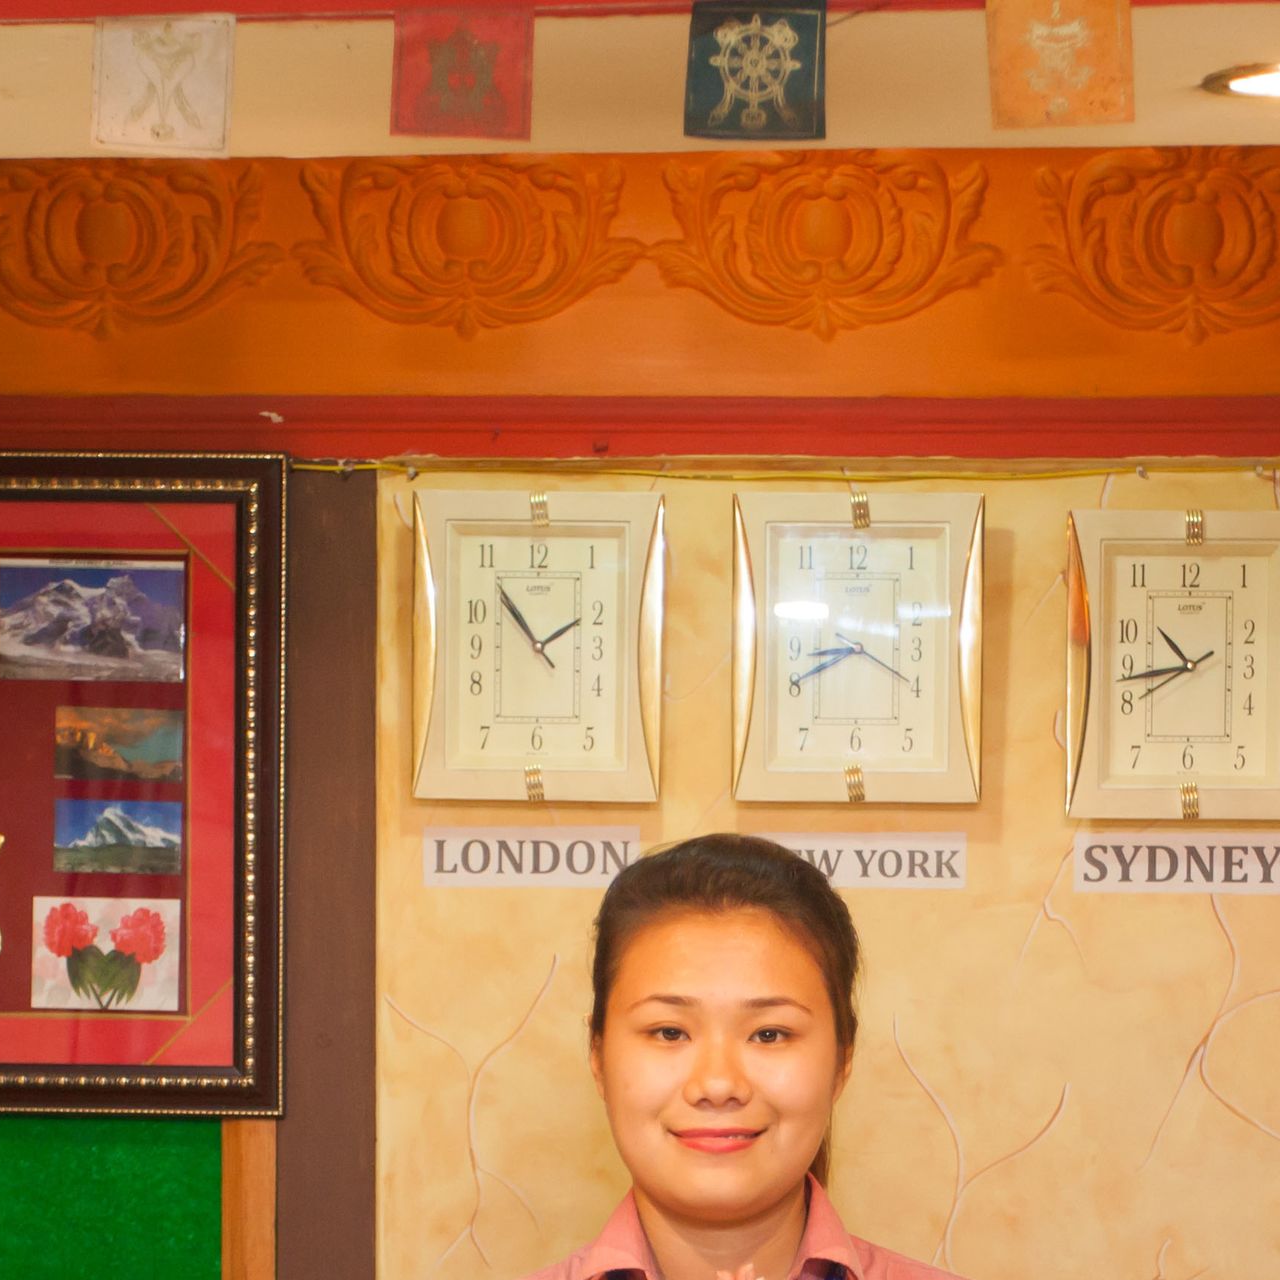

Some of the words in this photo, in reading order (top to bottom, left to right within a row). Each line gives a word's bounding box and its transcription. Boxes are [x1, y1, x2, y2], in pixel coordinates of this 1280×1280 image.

[479, 544, 494, 568] 11
[529, 543, 548, 569] 12
[588, 545, 595, 569] 1
[799, 545, 814, 570] 11
[848, 545, 867, 570] 12
[908, 546, 914, 570] 1
[1131, 563, 1146, 588] 11
[1181, 563, 1200, 588] 12
[1241, 564, 1247, 588] 1
[467, 599, 486, 624] 10
[592, 600, 603, 625] 2
[912, 602, 922, 626] 2
[1119, 618, 1138, 644] 10
[1244, 619, 1255, 644] 2
[470, 634, 482, 660] 9
[592, 636, 603, 661] 3
[790, 636, 801, 661] 9
[911, 637, 922, 662] 3
[1122, 654, 1133, 680] 9
[1243, 654, 1255, 680] 3
[470, 671, 482, 696] 8
[592, 674, 603, 697] 4
[789, 672, 801, 697] 8
[910, 675, 921, 698] 4
[1121, 690, 1133, 715] 8
[1243, 693, 1254, 716] 4
[480, 725, 490, 750] 7
[531, 726, 543, 751] 6
[583, 727, 595, 751] 5
[799, 728, 809, 752] 7
[850, 727, 861, 752] 6
[902, 728, 913, 752] 5
[1130, 745, 1141, 769] 7
[1182, 745, 1194, 770] 6
[1234, 745, 1245, 770] 5
[434, 839, 629, 875] LONDON
[853, 849, 960, 879] YORK
